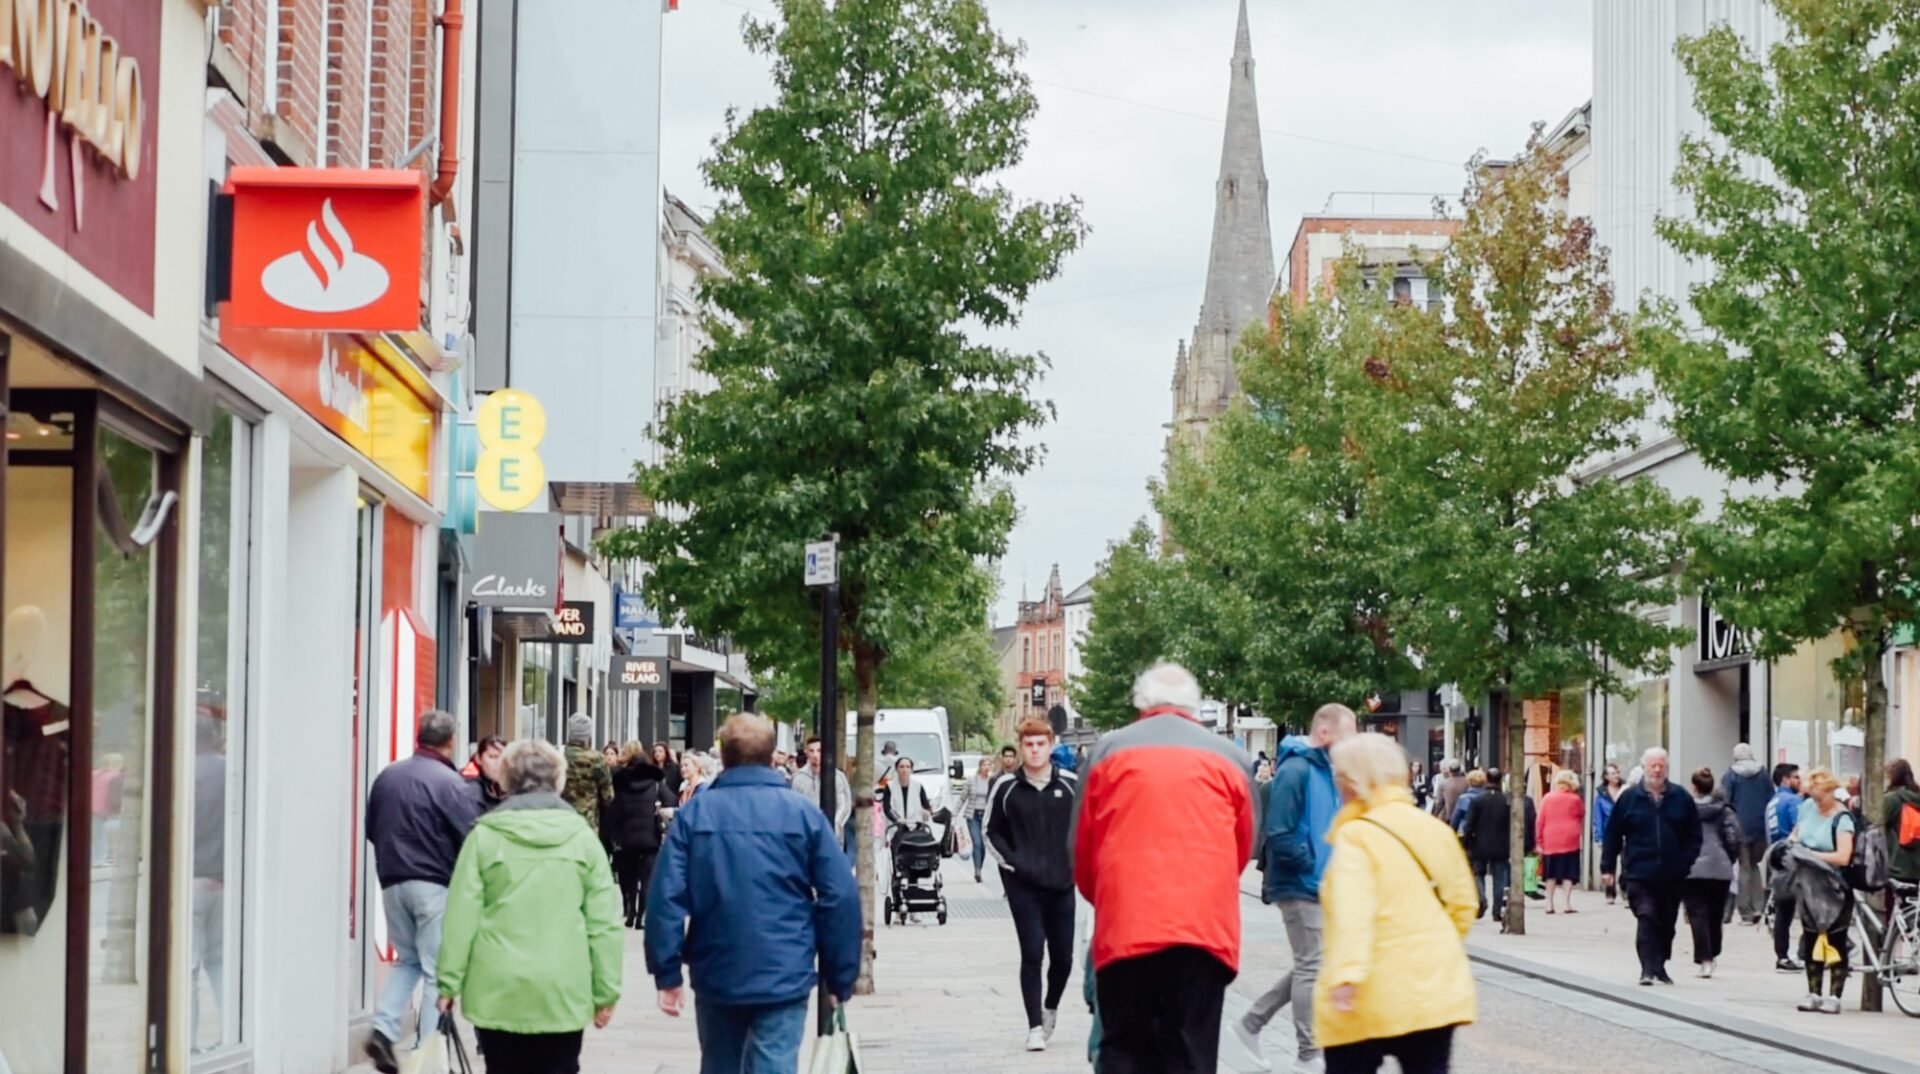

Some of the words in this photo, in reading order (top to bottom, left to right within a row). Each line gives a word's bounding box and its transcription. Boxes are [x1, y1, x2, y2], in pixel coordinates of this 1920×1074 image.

[472, 575, 546, 597] Clarks
[558, 622, 586, 635] AND
[625, 661, 656, 672] RIVER
[621, 673, 660, 684] ISLAND
